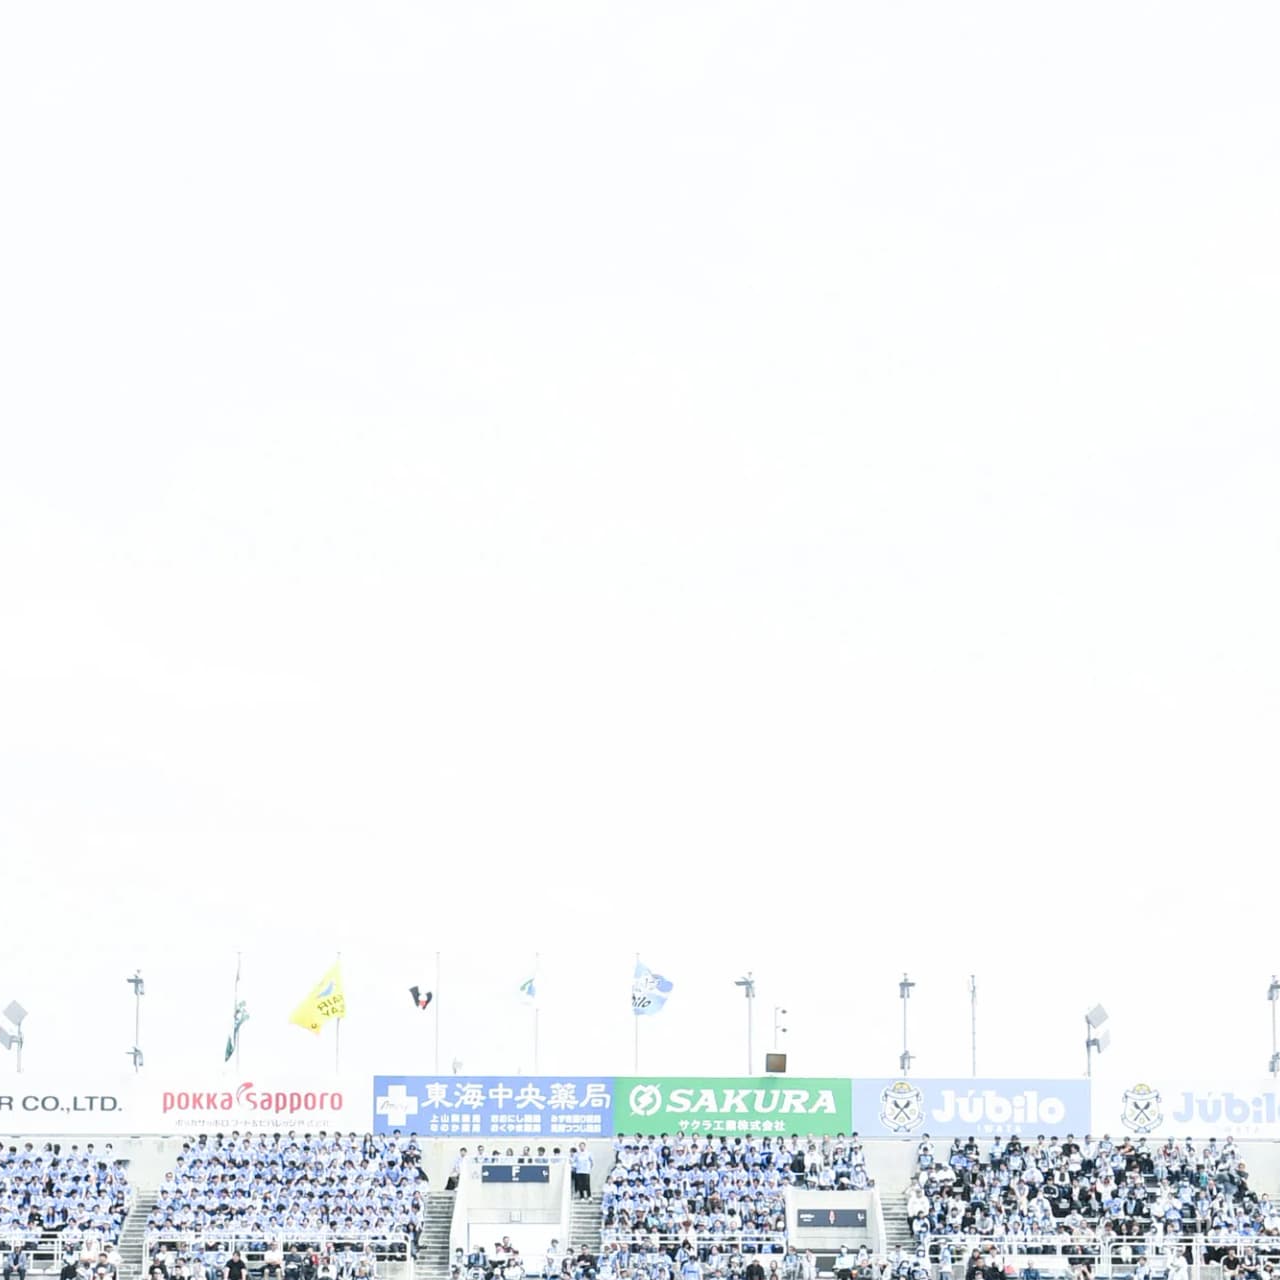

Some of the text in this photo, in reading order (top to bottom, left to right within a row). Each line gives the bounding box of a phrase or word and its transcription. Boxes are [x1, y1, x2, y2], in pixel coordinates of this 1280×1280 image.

[422, 1083, 611, 1109] 東海中央薬局
[666, 1089, 837, 1114] SAKURA
